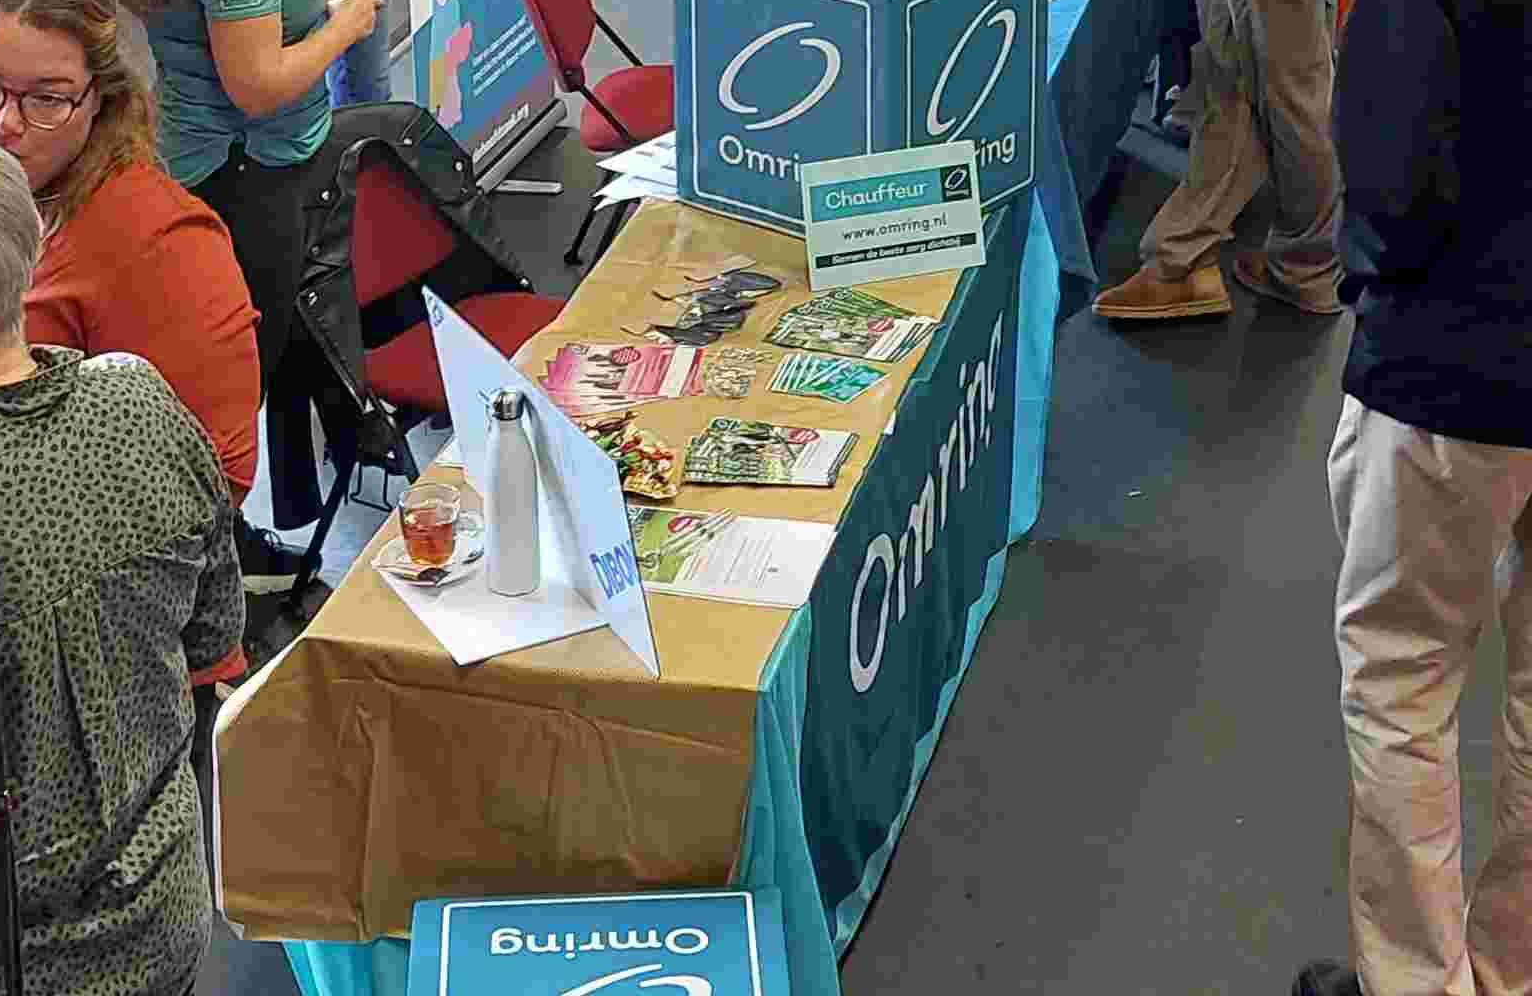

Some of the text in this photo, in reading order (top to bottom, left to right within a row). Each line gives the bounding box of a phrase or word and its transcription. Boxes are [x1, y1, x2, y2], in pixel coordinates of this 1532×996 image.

[719, 135, 801, 183] Omri
[825, 181, 930, 210] Chauffeur
[842, 211, 948, 242] www.omring.nl
[850, 310, 1004, 693] Omring
[490, 926, 710, 960] Omring
